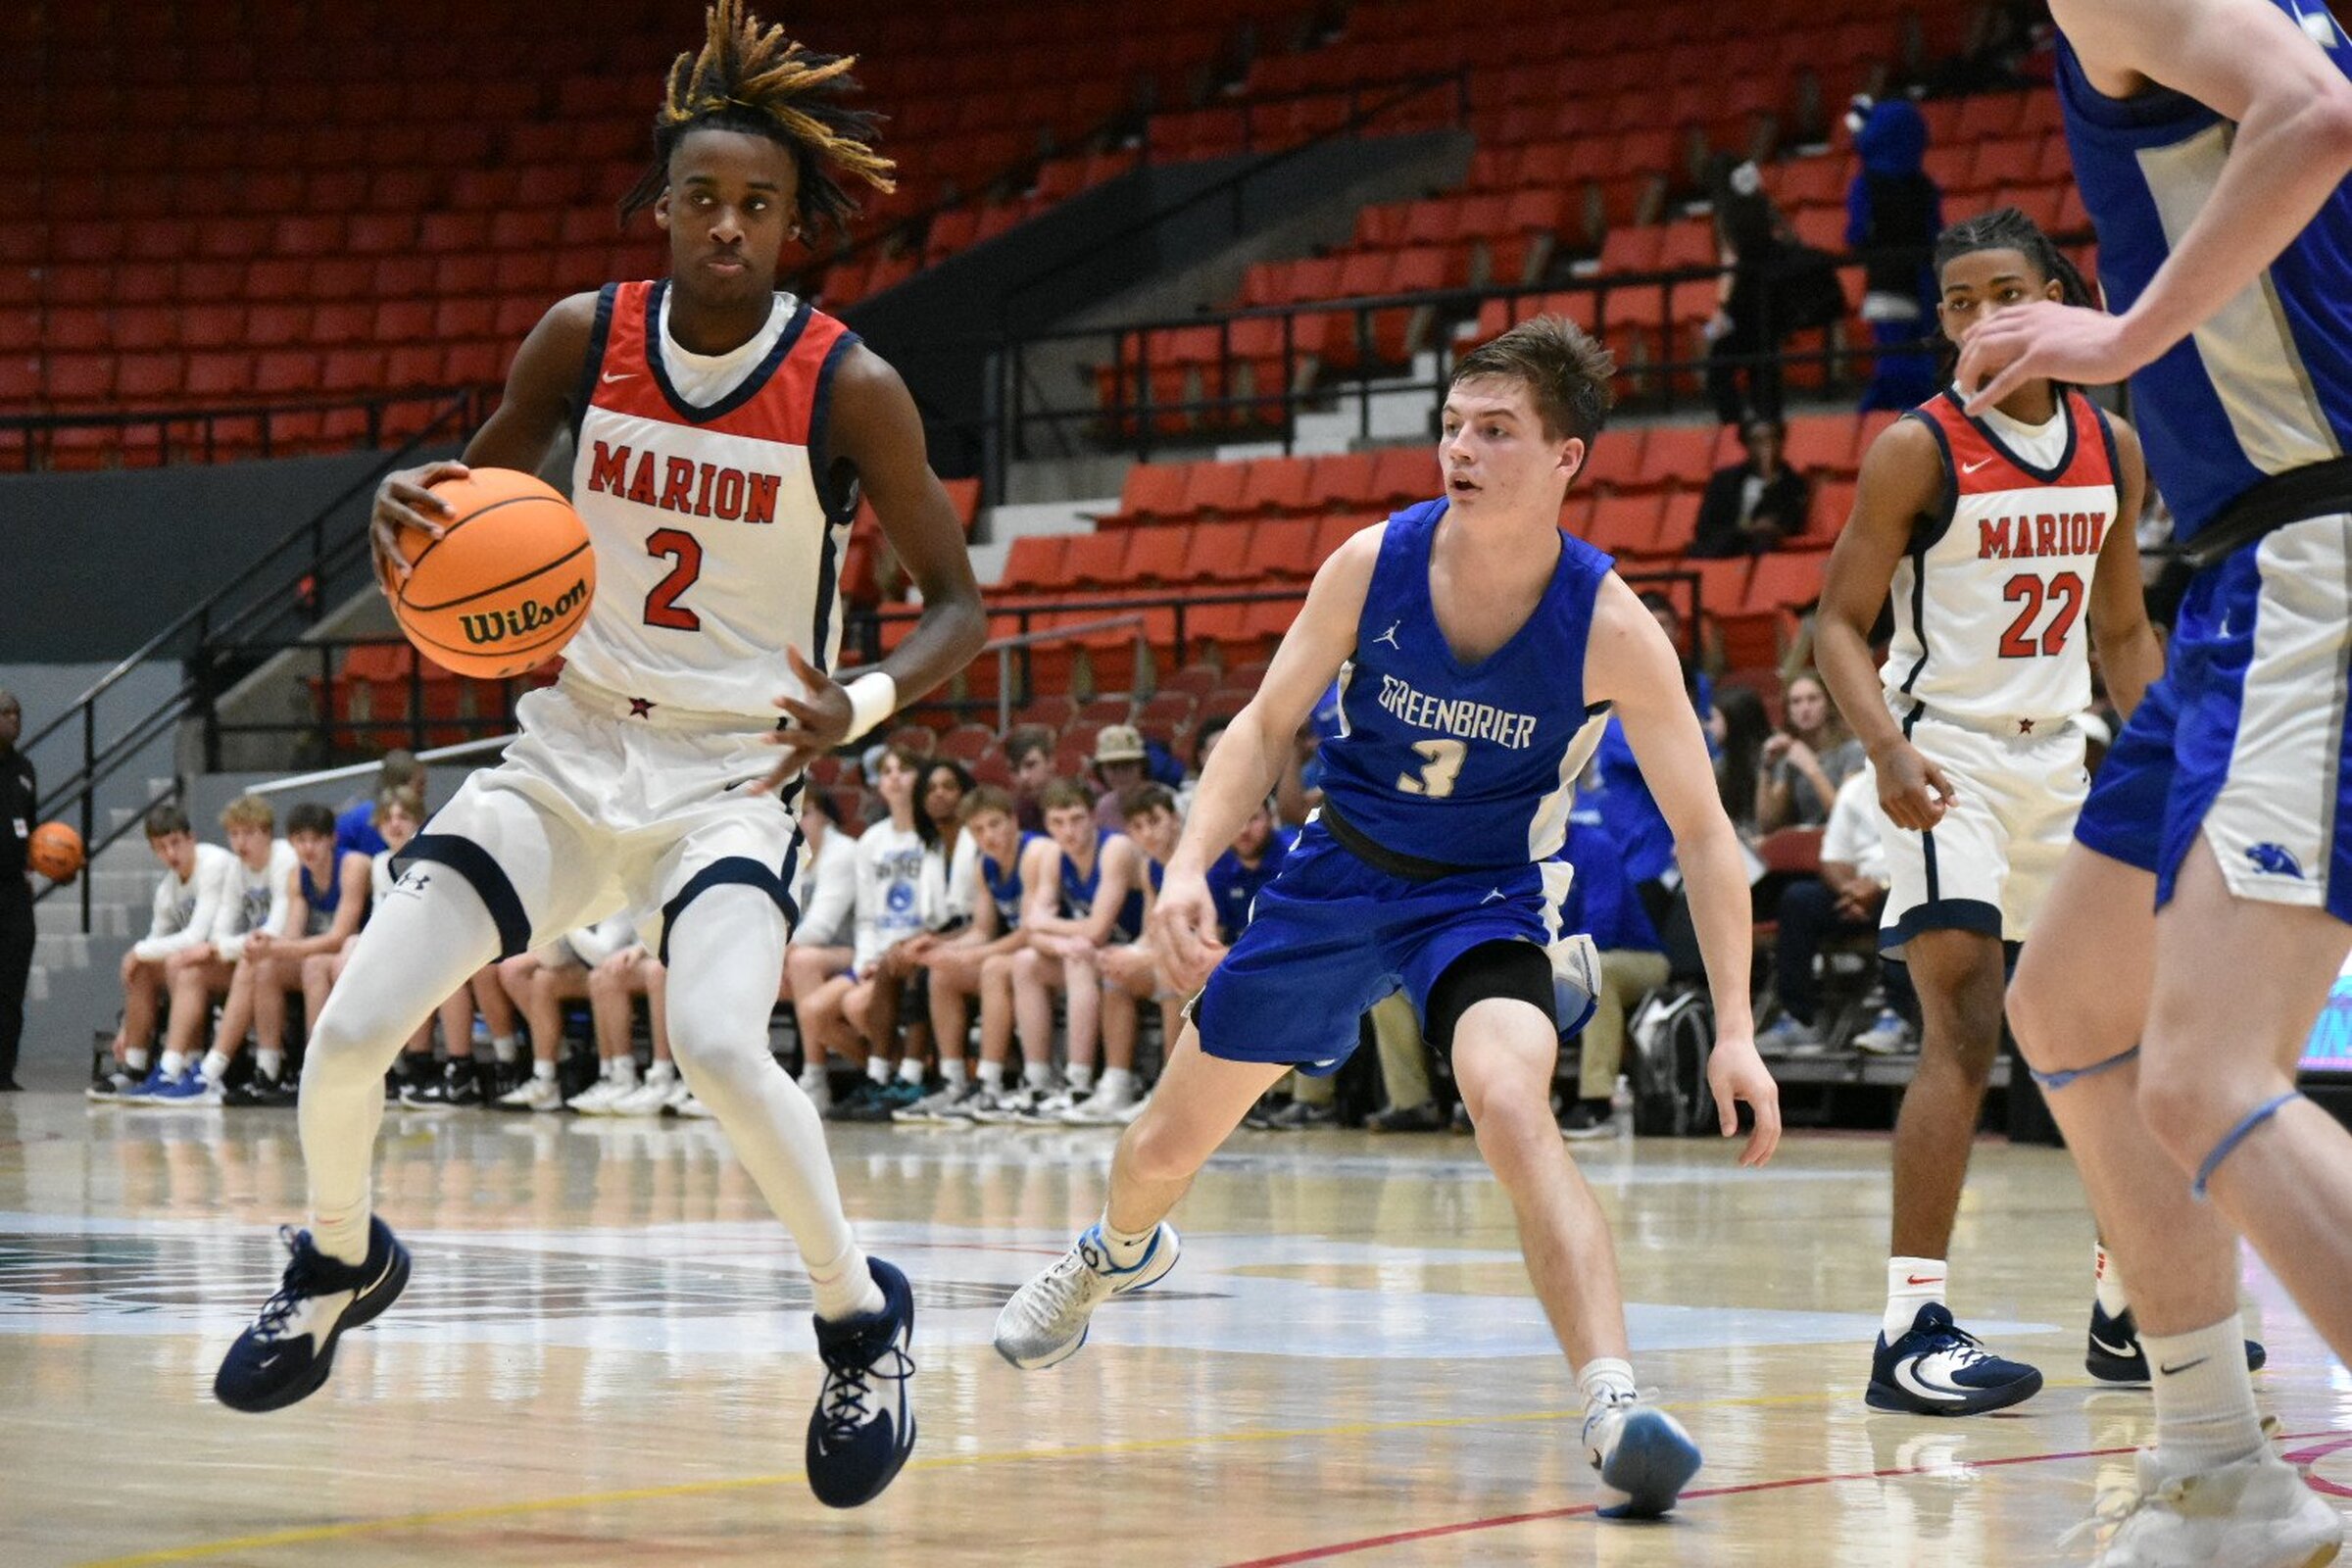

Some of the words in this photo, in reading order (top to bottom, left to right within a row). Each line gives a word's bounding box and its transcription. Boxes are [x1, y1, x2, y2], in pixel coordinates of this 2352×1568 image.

[589, 440, 782, 524] MARION
[1978, 512, 2106, 560] MARION
[459, 578, 586, 644] Wilson
[643, 527, 703, 632] 2
[1998, 571, 2084, 659] 22
[1378, 673, 1538, 750] GREENBRIER
[1396, 739, 1469, 800] 3
